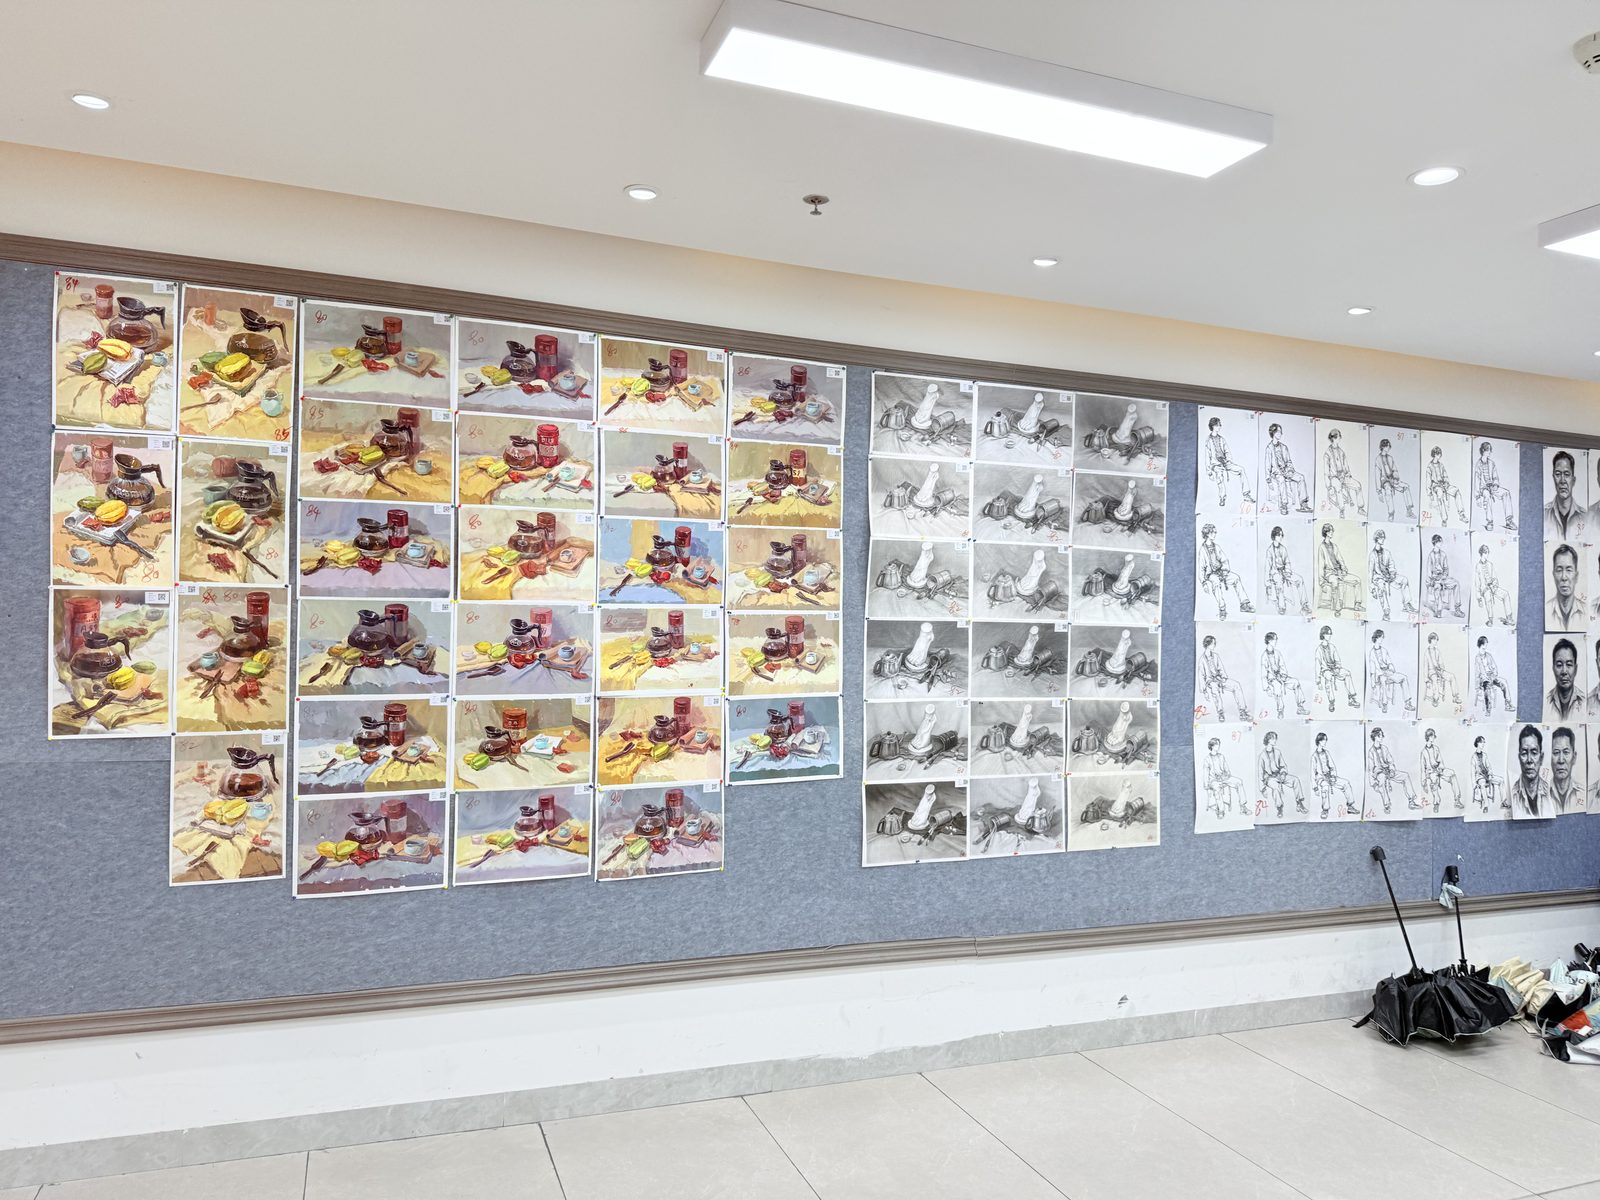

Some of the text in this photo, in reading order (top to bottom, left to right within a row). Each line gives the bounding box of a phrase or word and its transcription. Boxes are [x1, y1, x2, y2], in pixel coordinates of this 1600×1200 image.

[64, 276, 79, 292] 84
[309, 404, 324, 419] 85
[275, 426, 293, 441] 85
[306, 505, 321, 521] 84
[468, 514, 482, 529] 80
[265, 547, 279, 560] 80
[142, 564, 159, 582] 80
[224, 590, 238, 601] 80
[466, 611, 480, 624] 80
